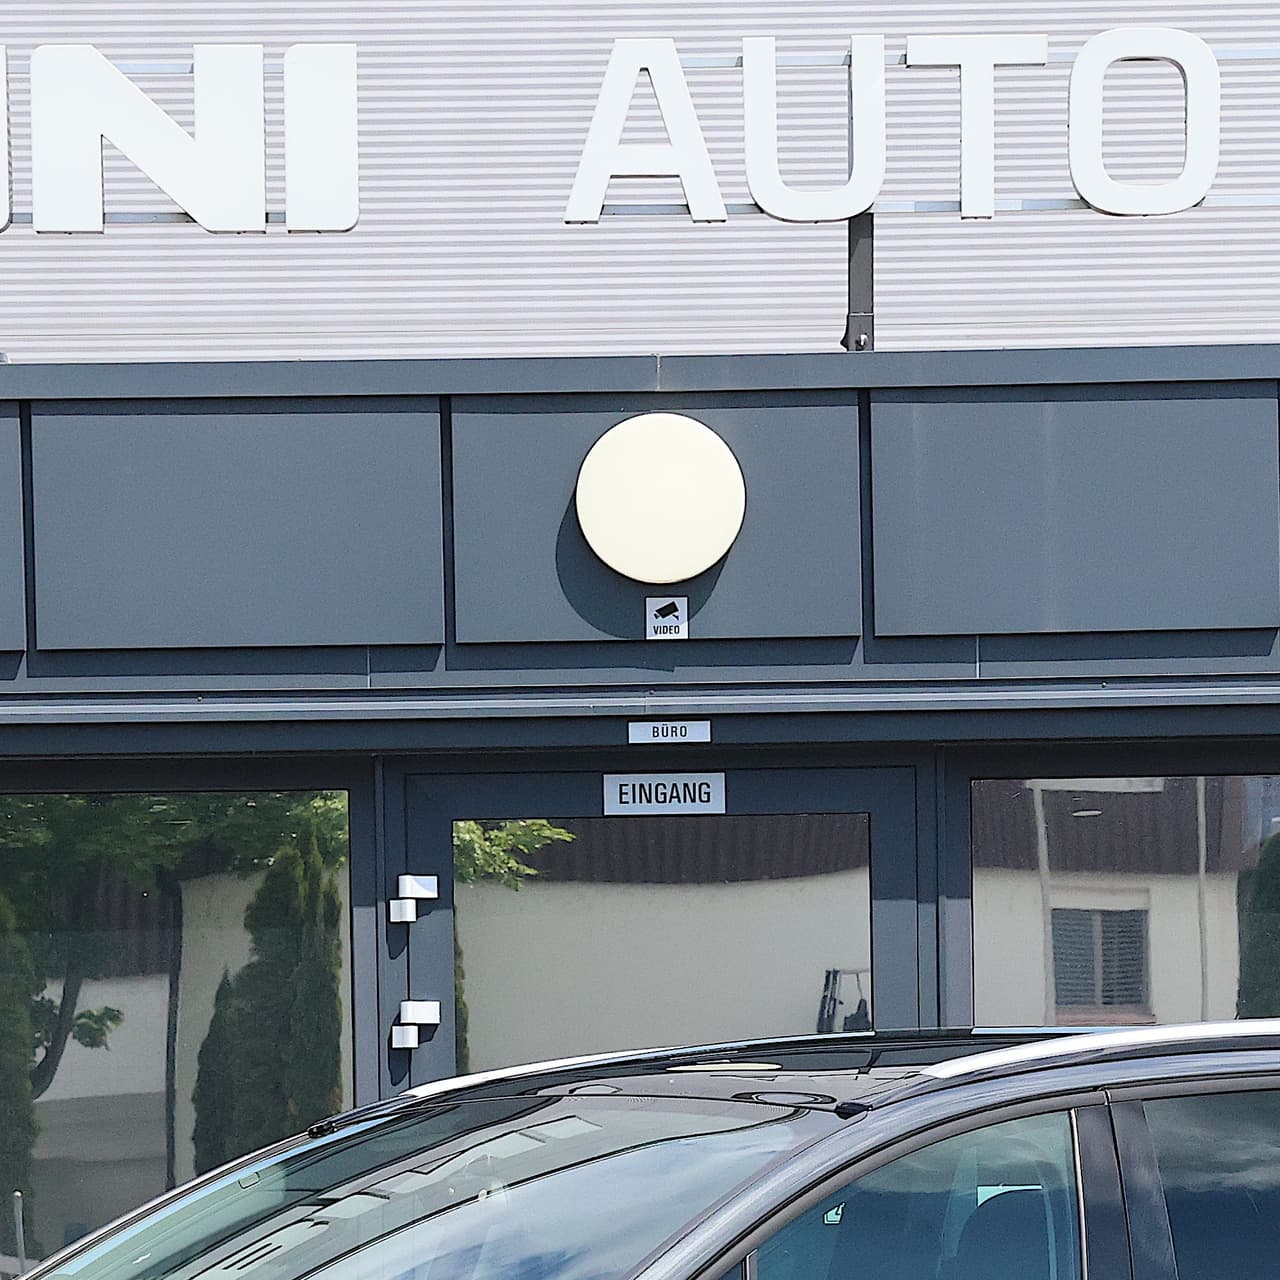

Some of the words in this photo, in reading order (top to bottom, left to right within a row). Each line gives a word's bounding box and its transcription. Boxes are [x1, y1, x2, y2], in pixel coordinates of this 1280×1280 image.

[563, 27, 1222, 224] AUTO
[653, 625, 680, 635] VIDEO
[652, 723, 688, 738] BÜRO
[618, 782, 712, 805] EINGANG
